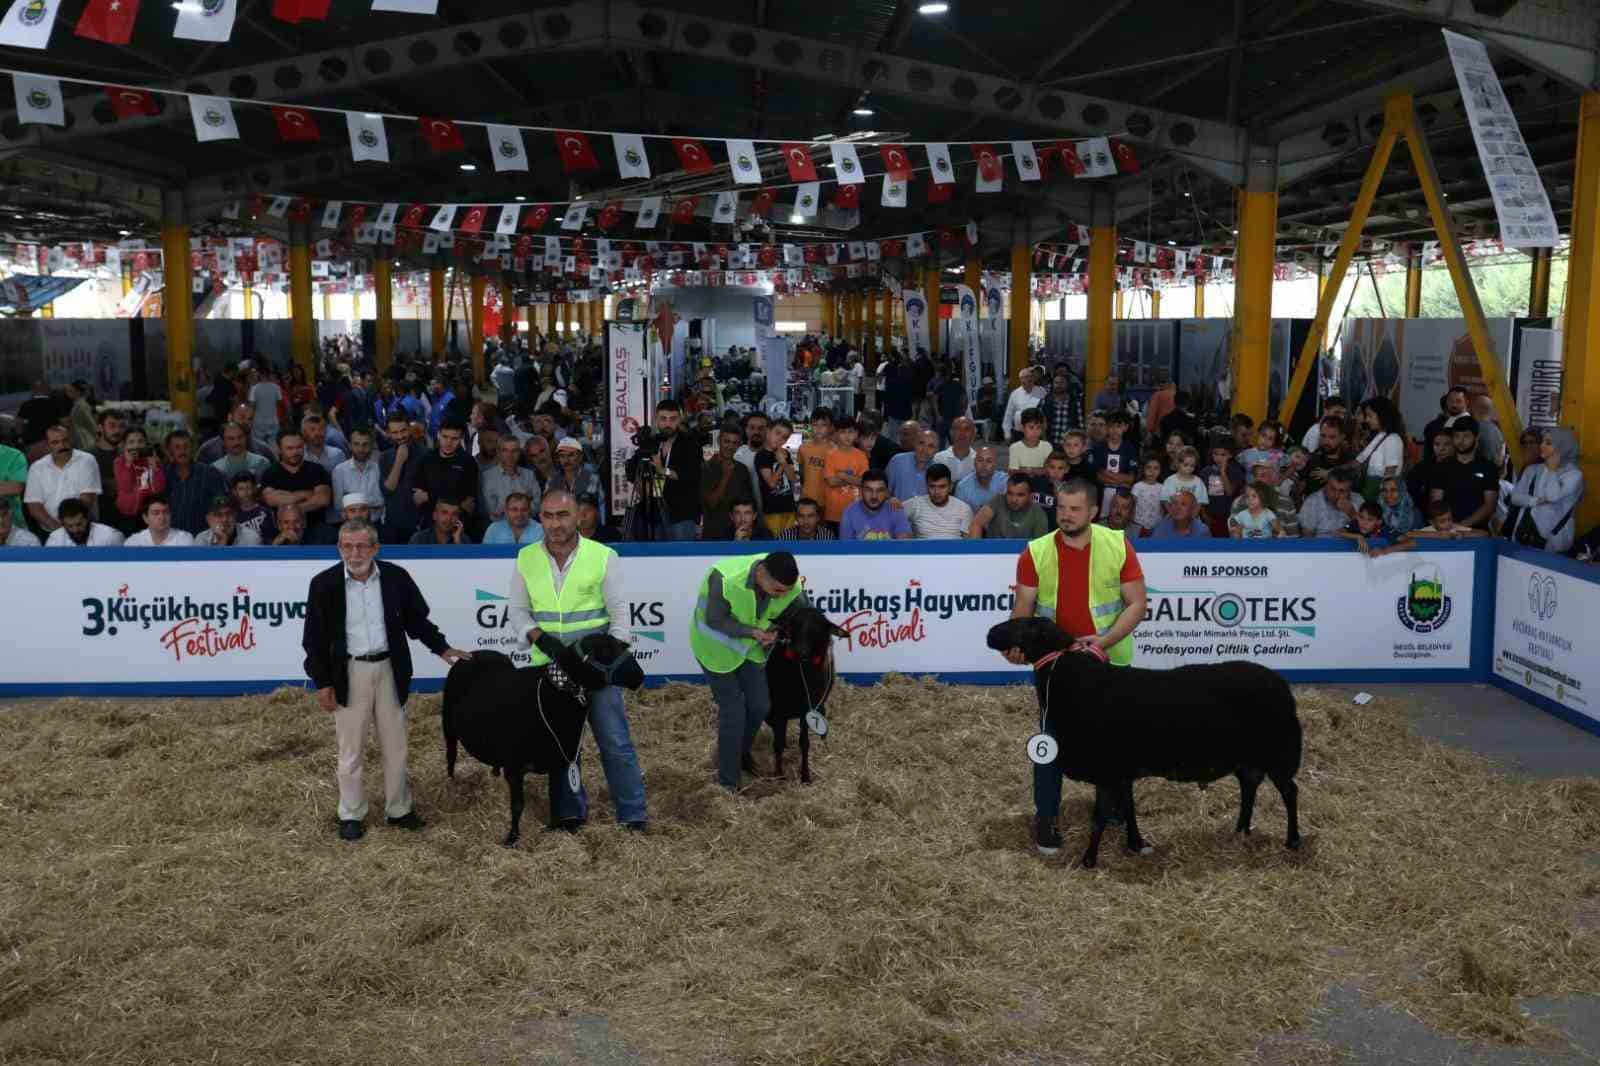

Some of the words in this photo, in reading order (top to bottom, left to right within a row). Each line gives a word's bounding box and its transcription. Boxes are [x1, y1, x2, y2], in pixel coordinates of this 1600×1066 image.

[1183, 566, 1208, 577] ANA
[1211, 566, 1268, 577] SPONSOR
[107, 595, 229, 629] Küçükbaş
[839, 607, 925, 652] Festivali
[1240, 630, 1260, 639] Proje
[160, 616, 256, 661] Festivali
[1216, 643, 1250, 656] Çiftlik
[812, 715, 820, 728] 7
[1036, 740, 1048, 757] 6
